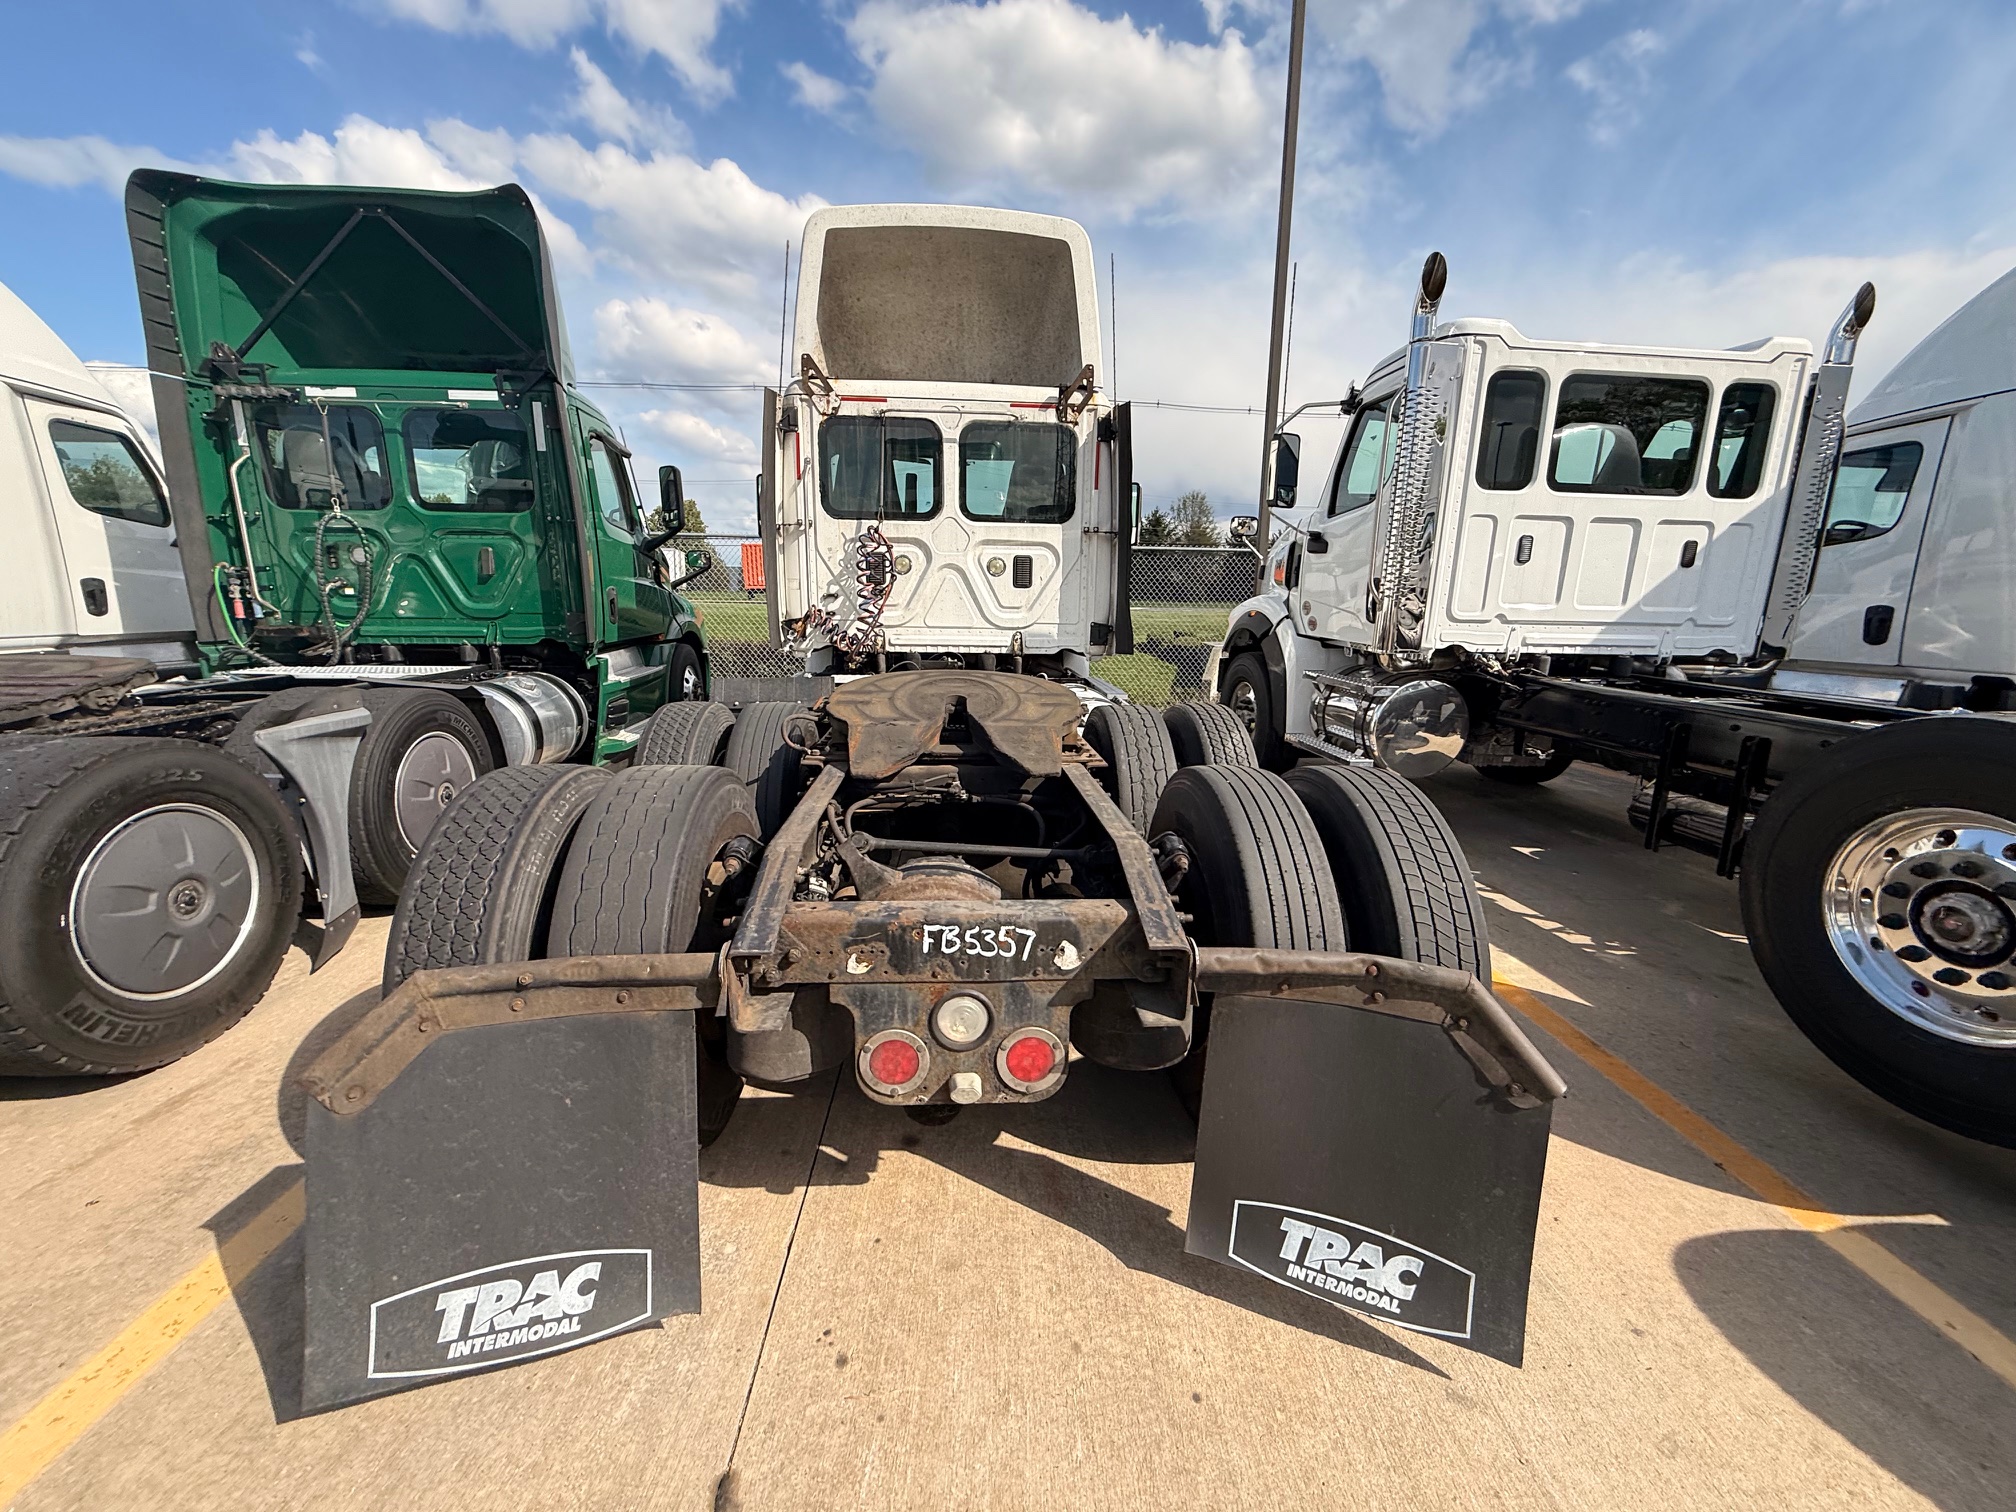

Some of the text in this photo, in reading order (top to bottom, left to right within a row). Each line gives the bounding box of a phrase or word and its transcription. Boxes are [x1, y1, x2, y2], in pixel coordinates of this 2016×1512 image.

[452, 716, 485, 758] MICHELIN
[921, 923, 1037, 962] FB5357
[1279, 1216, 1425, 1301] TRAC
[434, 1261, 603, 1344] TRAC
[1286, 1263, 1402, 1314] INTERMODAL
[446, 1315, 582, 1360] INTERMODAL
